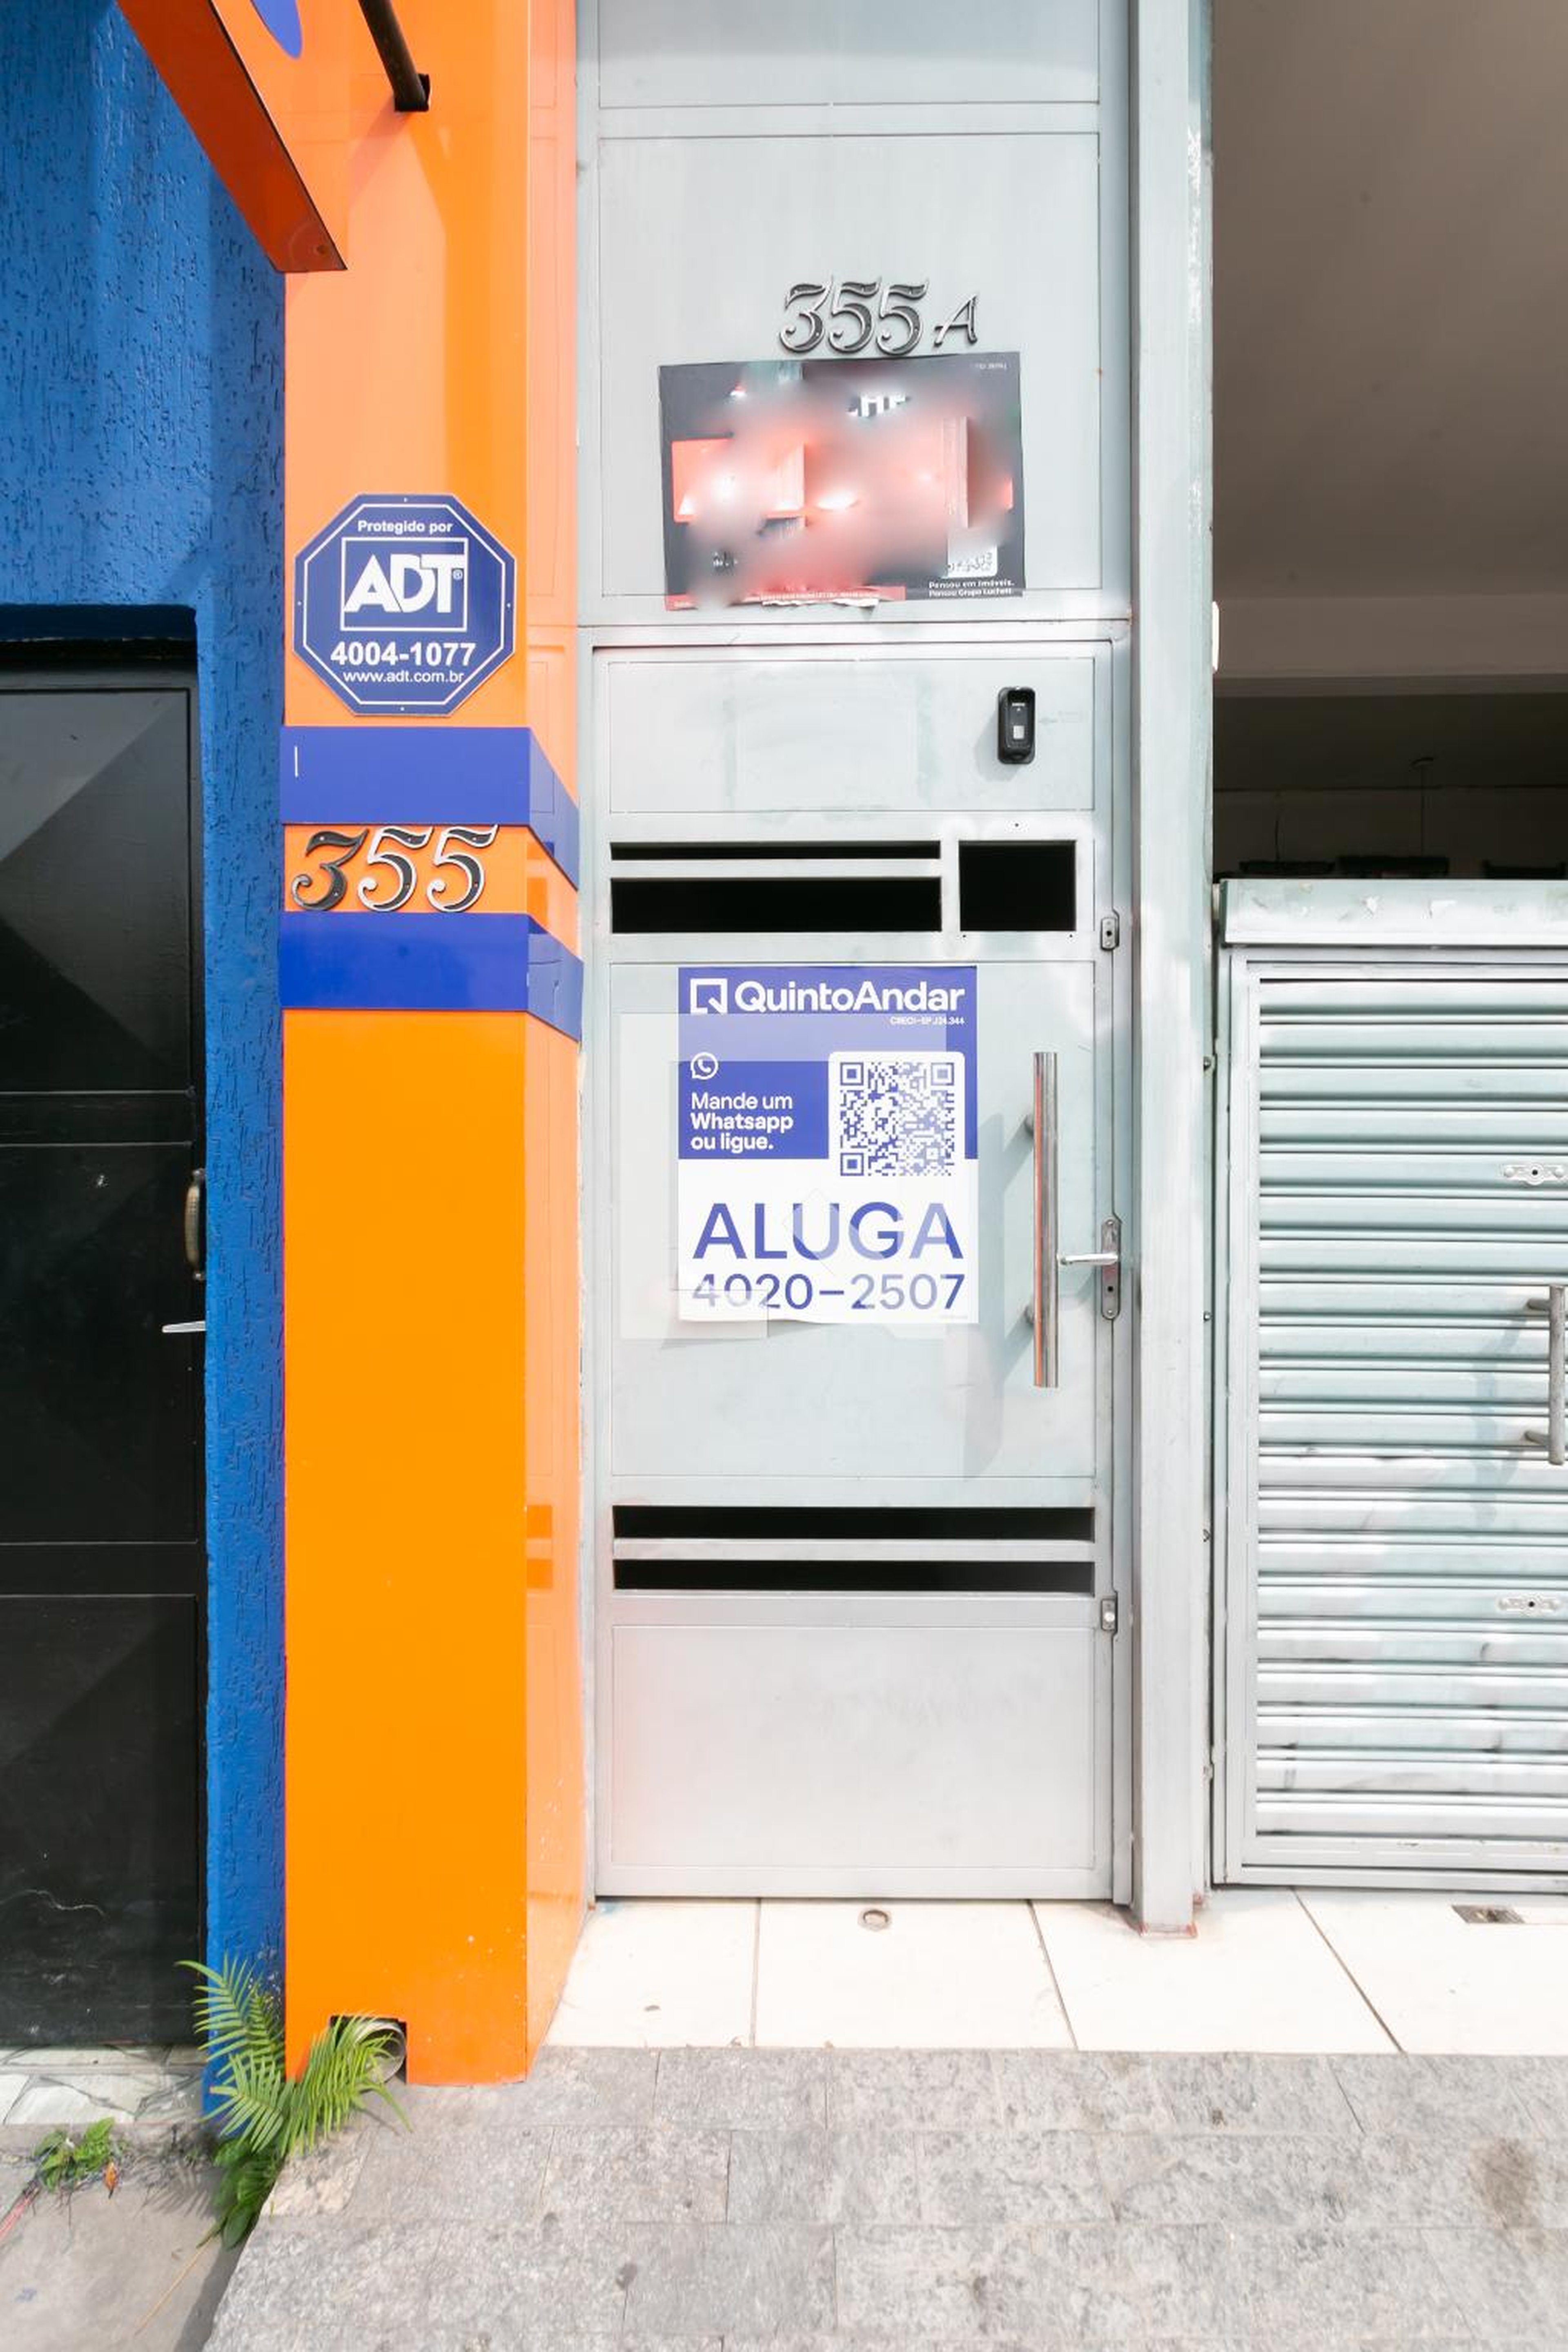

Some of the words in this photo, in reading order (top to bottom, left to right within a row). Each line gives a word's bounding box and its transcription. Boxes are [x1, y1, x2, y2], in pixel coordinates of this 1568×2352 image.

[779, 275, 930, 355] 355
[933, 292, 980, 347] A
[357, 520, 426, 535] Protegido
[430, 522, 453, 535] por
[330, 641, 477, 666] 4004-1077
[343, 670, 465, 684] www.adt.com.br
[291, 824, 499, 913] 355
[735, 981, 965, 1013] QuintoAndar
[691, 1092, 760, 1110] Mande
[762, 1095, 793, 1110] um
[690, 1112, 794, 1134] Whatsapp
[691, 1136, 717, 1151] ou
[720, 1132, 773, 1154] ligue.
[693, 1202, 964, 1261] ALUGA
[693, 1274, 965, 1310] 4020-2507
